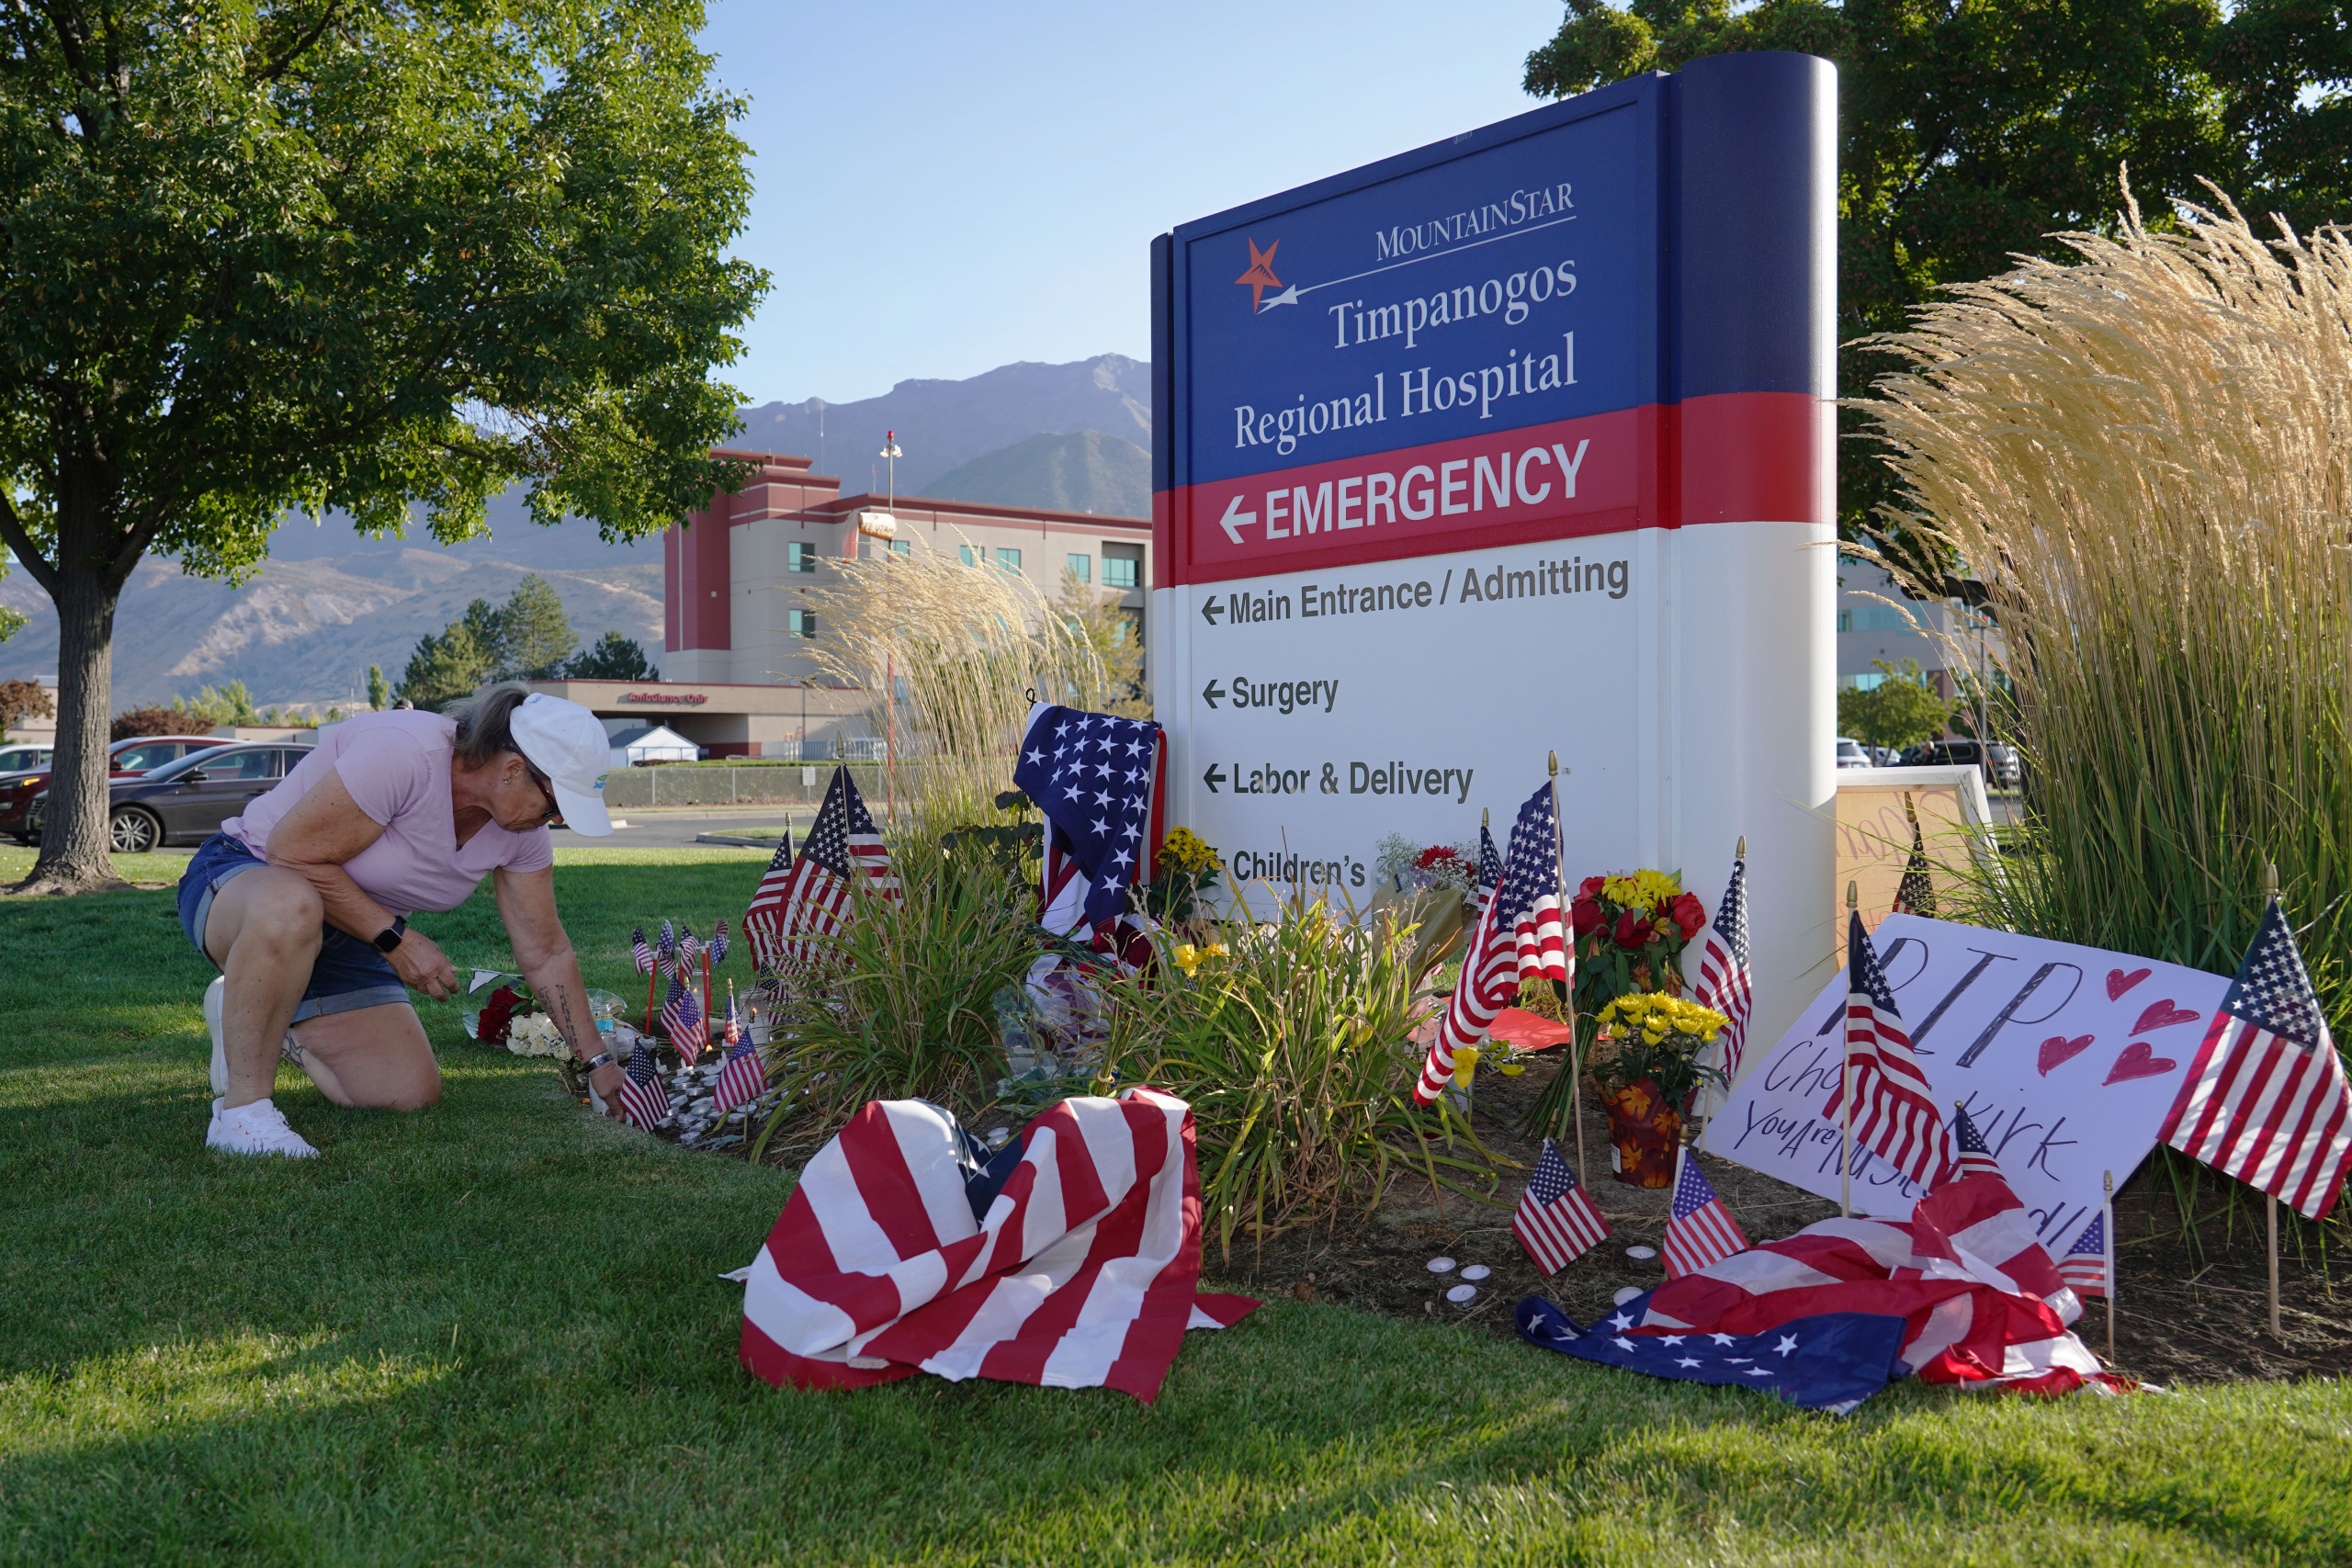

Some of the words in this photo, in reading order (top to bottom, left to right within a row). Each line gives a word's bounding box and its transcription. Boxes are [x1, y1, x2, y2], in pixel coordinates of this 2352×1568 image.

[1329, 259, 1577, 349] Timpanogos
[1234, 372, 1387, 456] Regional
[1399, 331, 1578, 420] Hospital
[1266, 438, 1590, 540] EMERGENCY
[1229, 589, 1291, 625] Main
[1301, 581, 1432, 618] Entrance
[1459, 556, 1629, 604] Admitting
[628, 693, 684, 702] Ambulance
[686, 694, 708, 704] Only
[1232, 676, 1339, 716] Surgery
[1234, 762, 1310, 795] Labor
[1319, 761, 1340, 795] &
[1350, 761, 1474, 805] Delivery
[1233, 850, 1365, 888] Children's
